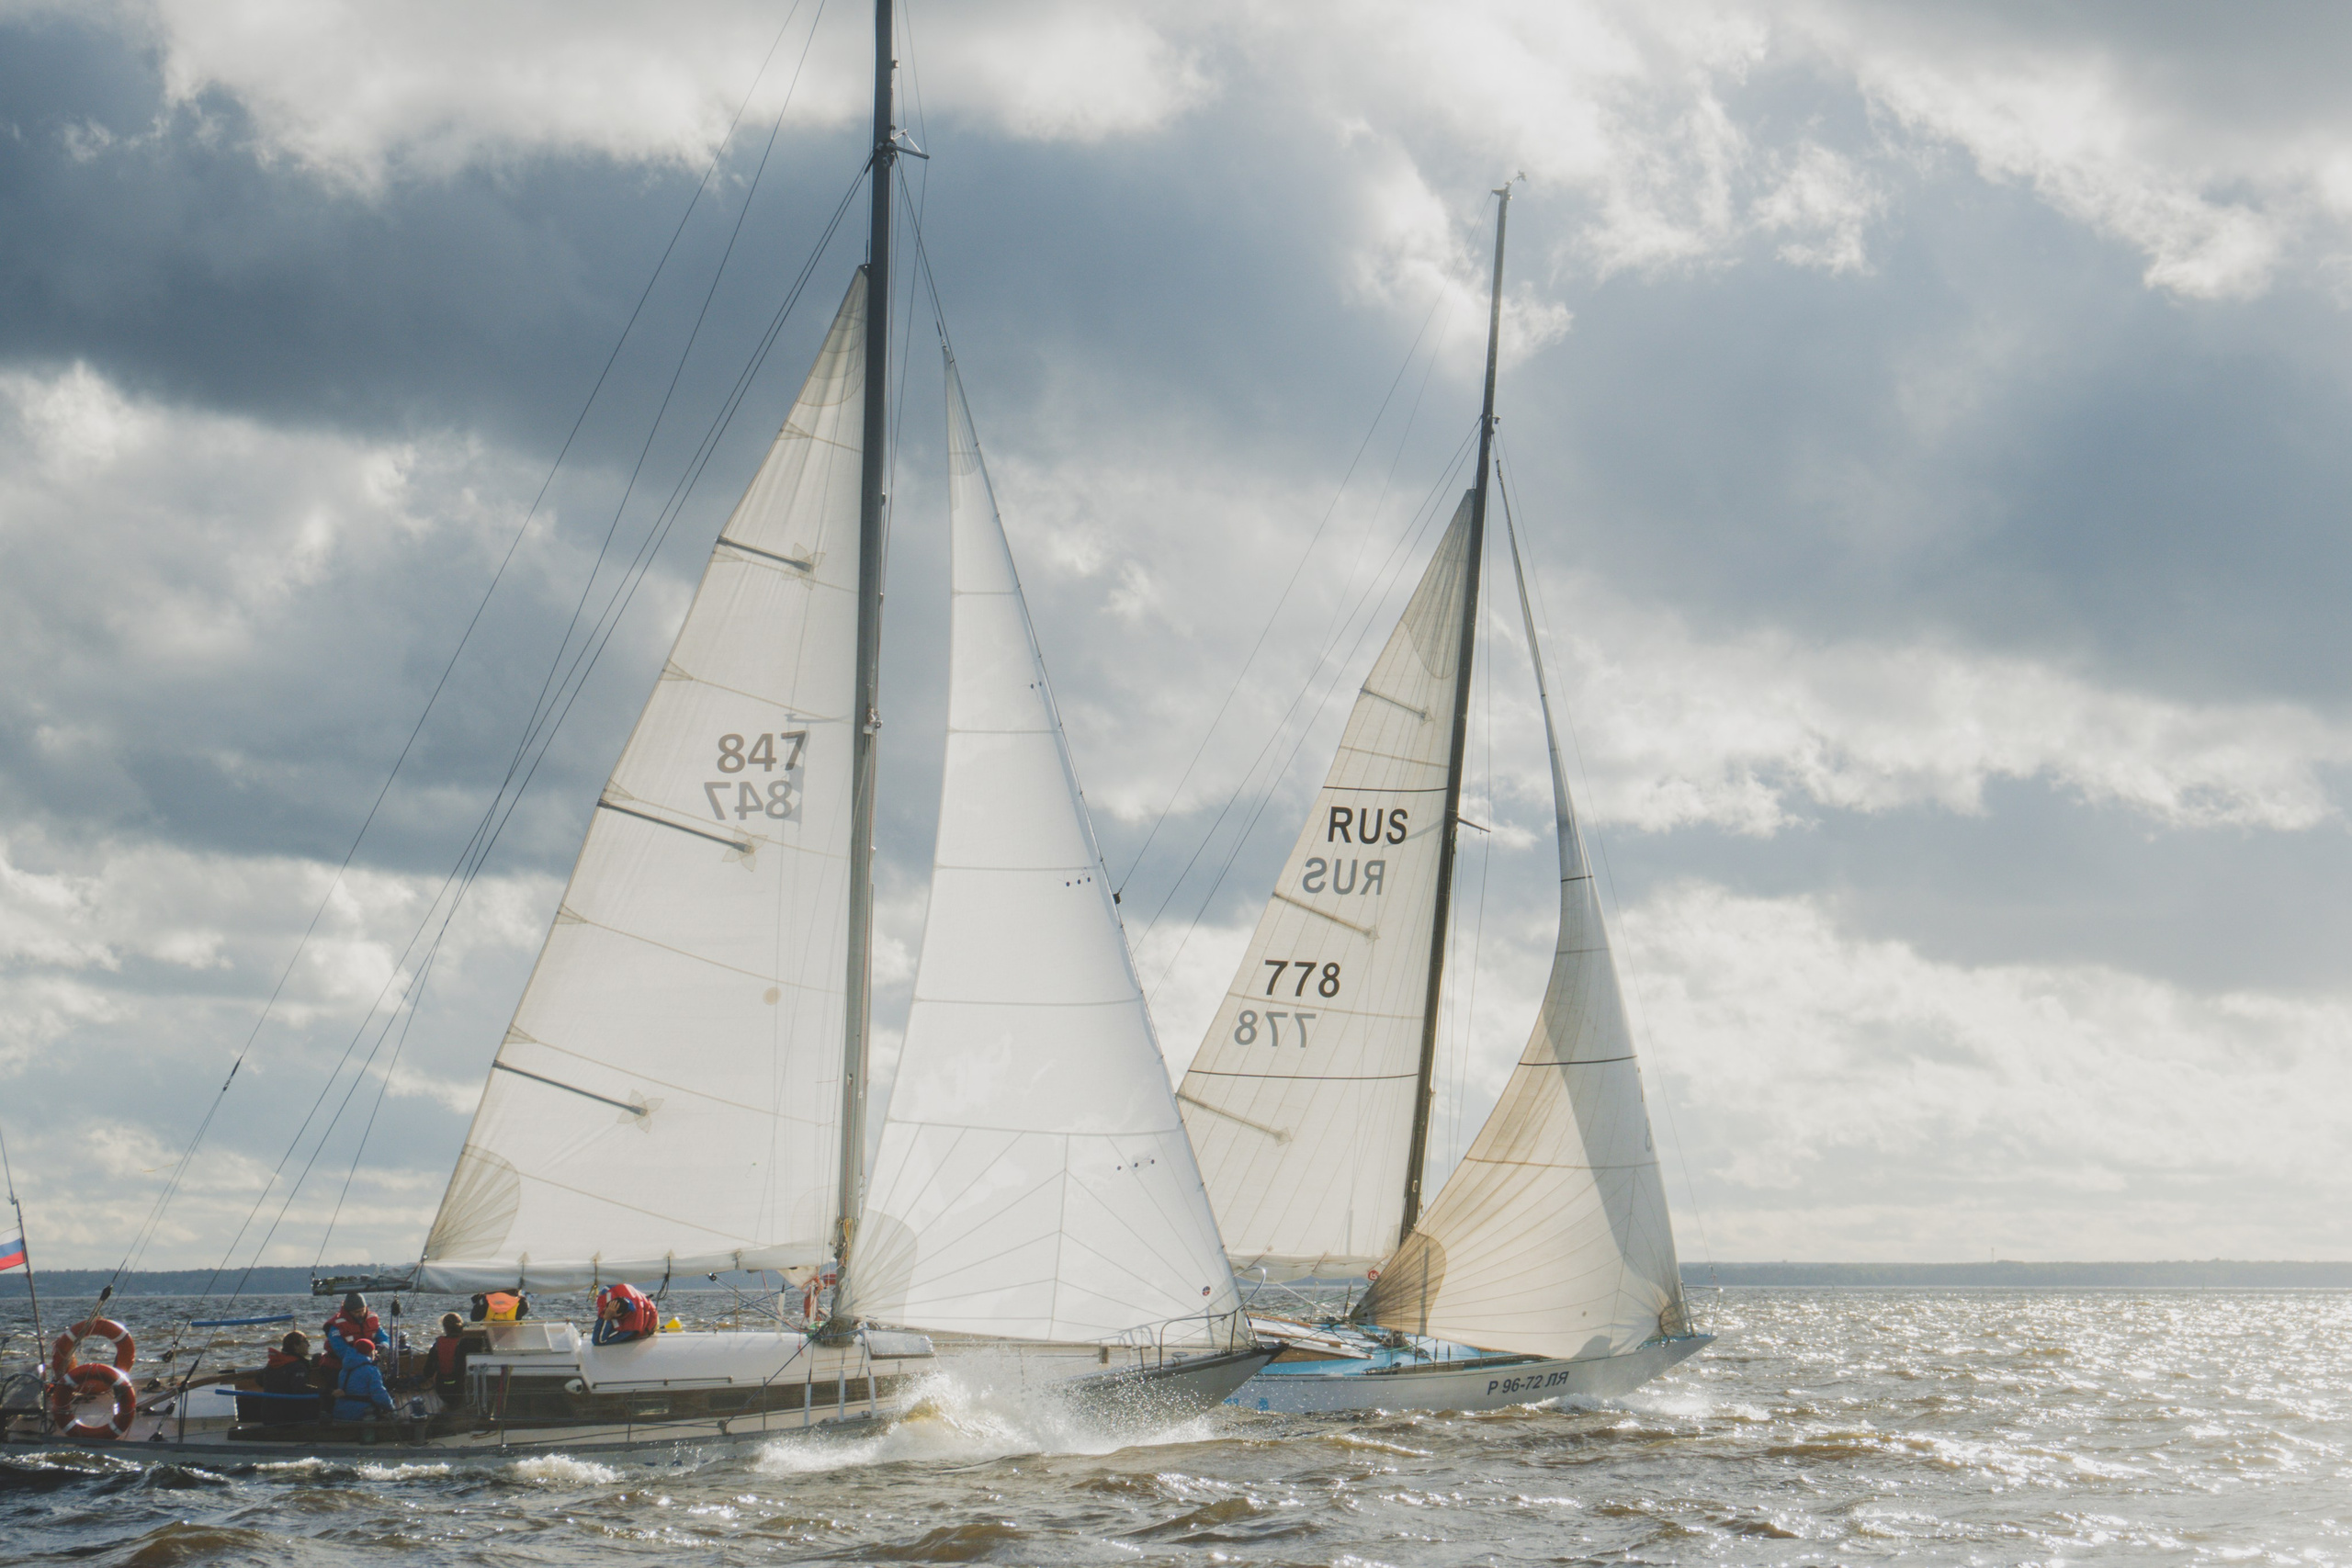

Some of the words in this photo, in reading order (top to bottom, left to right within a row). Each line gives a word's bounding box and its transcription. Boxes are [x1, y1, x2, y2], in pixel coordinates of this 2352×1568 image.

[717, 730, 807, 773] 847
[1327, 806, 1408, 845] RUS
[1264, 960, 1340, 998] 778
[1501, 1374, 1544, 1393] 96-72
[1544, 1371, 1569, 1388] ЛЯ
